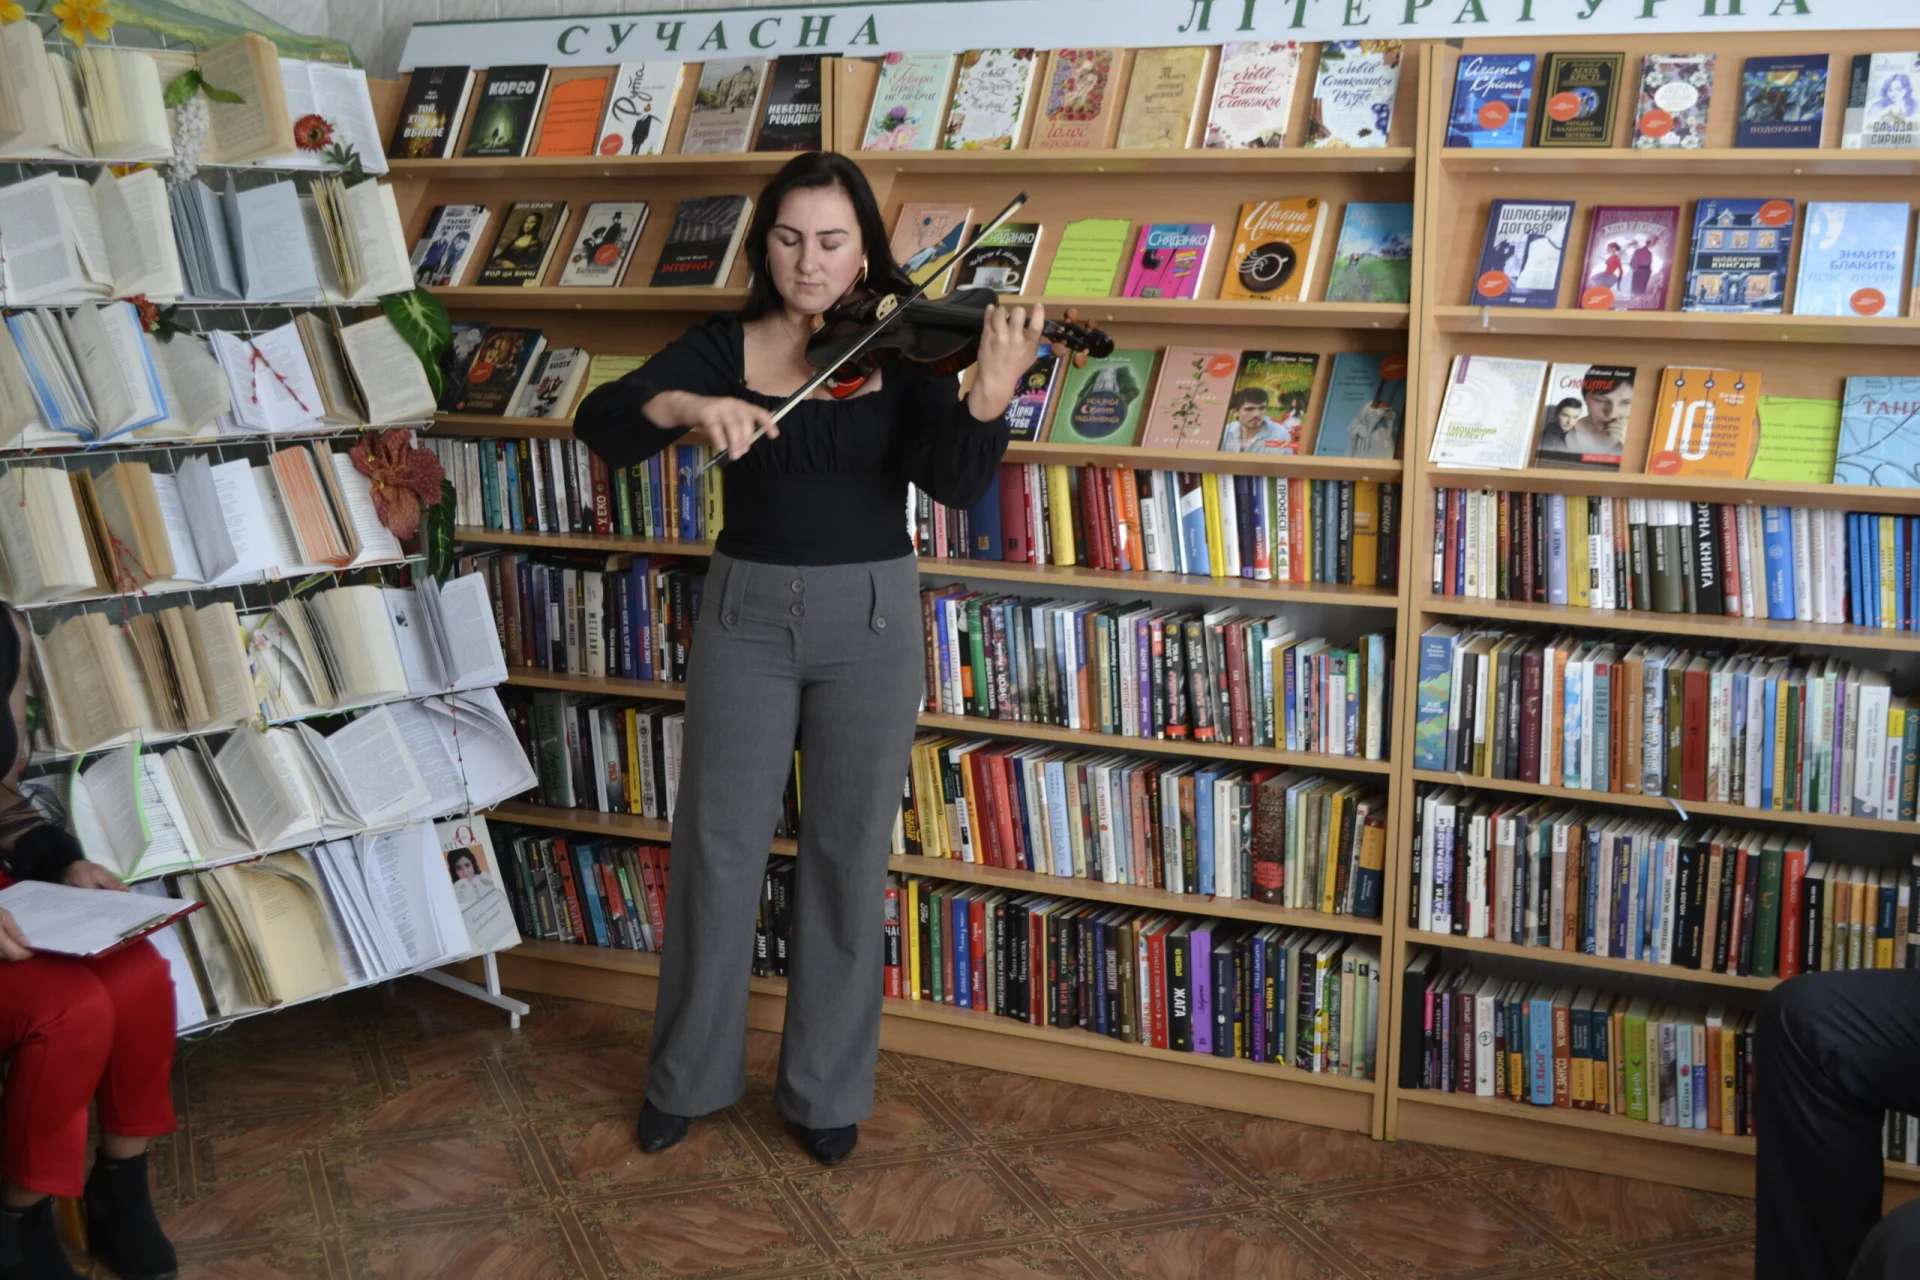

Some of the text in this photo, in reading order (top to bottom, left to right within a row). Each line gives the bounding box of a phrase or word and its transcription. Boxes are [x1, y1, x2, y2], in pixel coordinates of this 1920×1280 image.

[557, 14, 880, 55] СУЧАСНА
[1465, 57, 1519, 76] Агата
[489, 81, 536, 95] КОРСО
[1470, 77, 1525, 98] Крісті
[769, 114, 821, 126] РЕЦИДИВУ
[1750, 125, 1812, 134] ПОДОРОЖНІ
[404, 127, 444, 138] ВБИВАЄ
[1871, 134, 1912, 145] СИРИНА
[1502, 206, 1567, 221] ШЛЮБНИЙ
[1499, 222, 1552, 235] ДОГОВІР
[1148, 231, 1208, 248] Сняданко
[1839, 249, 1896, 260] ЗНАЙТИ
[662, 261, 716, 273] ІНТЕРНАТ
[1830, 261, 1895, 271] БЛАКИТЬ
[1560, 376, 1614, 394] Спокута
[1664, 400, 1716, 461] 10
[1278, 484, 1287, 532] ПРОФЕСІЇ
[1700, 542, 1713, 588] КНИГА
[677, 643, 685, 664] КІНГ
[1052, 802, 1065, 862] АПТЕКАР
[1434, 818, 1445, 921] БРАТИ КАПРАНОВИ
[758, 934, 766, 958] КІНГ
[778, 938, 786, 958] КІНГ
[1174, 988, 1186, 1018] ЖАГА
[1536, 1050, 1546, 1080] ХЬОГ
